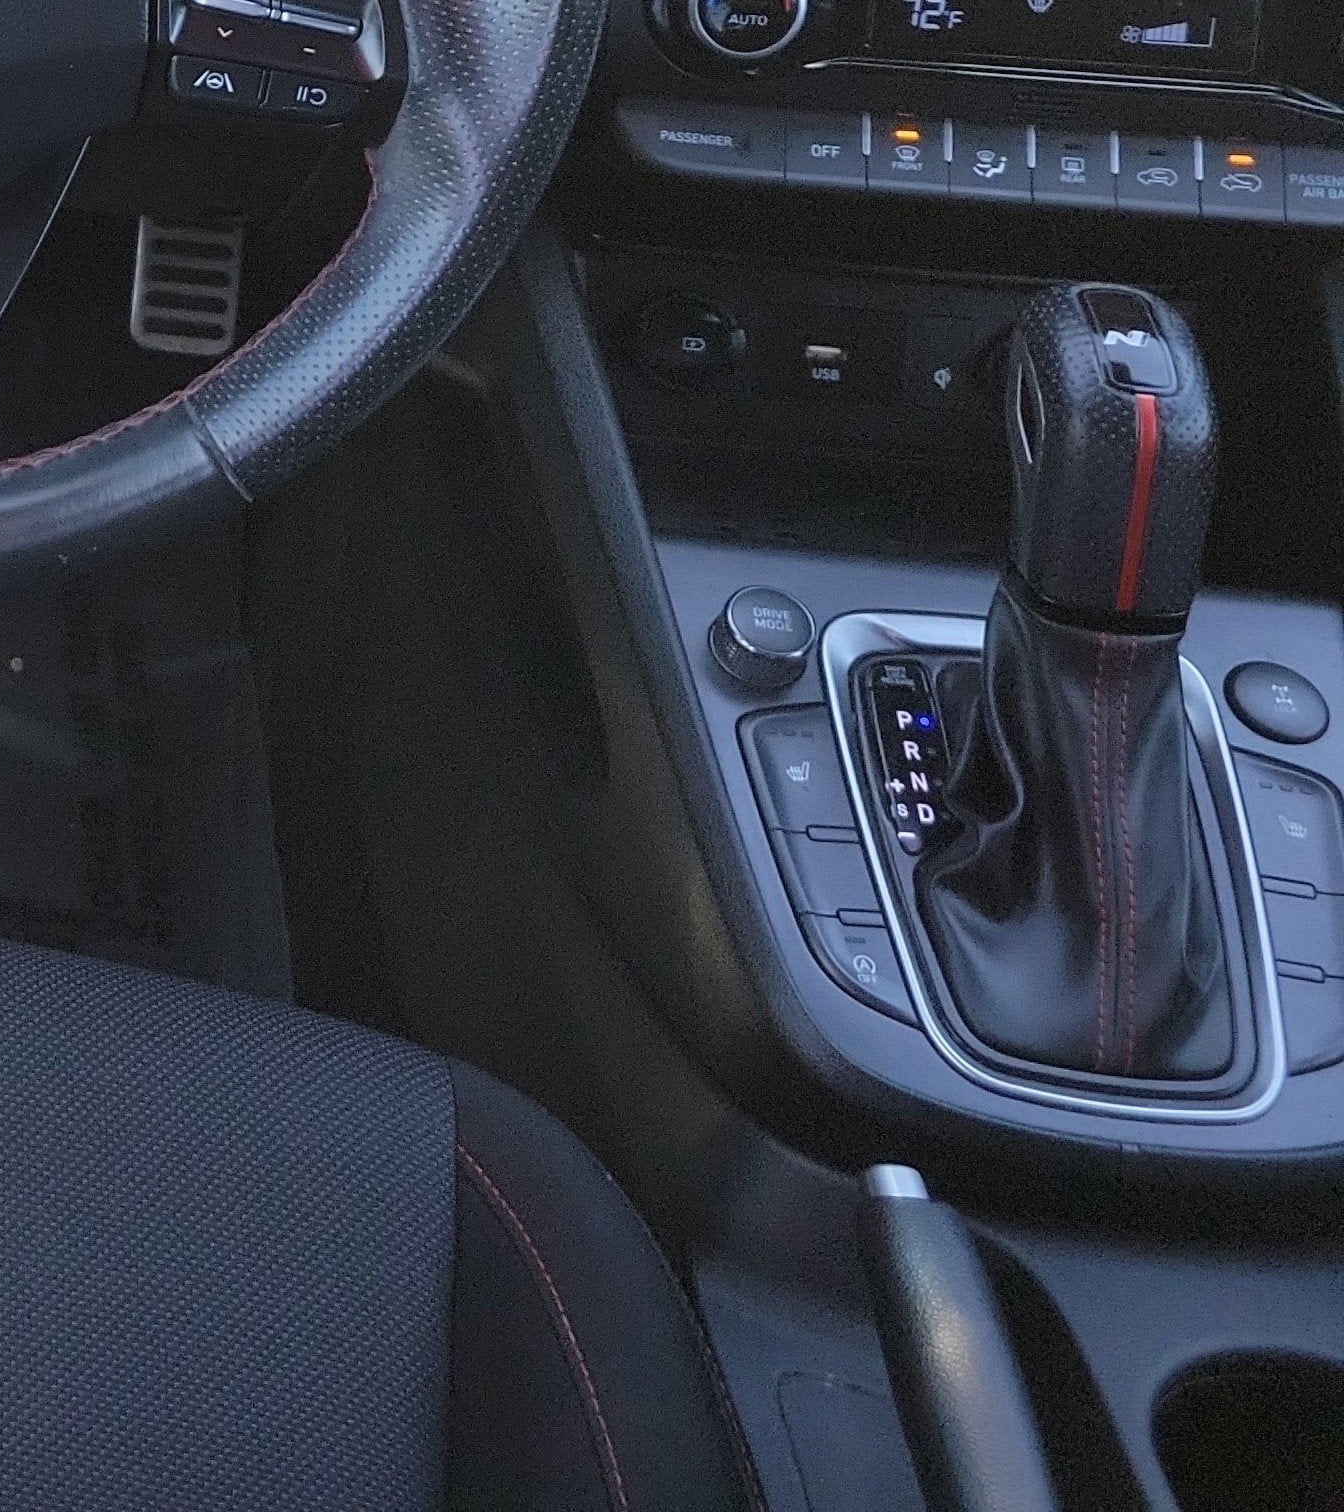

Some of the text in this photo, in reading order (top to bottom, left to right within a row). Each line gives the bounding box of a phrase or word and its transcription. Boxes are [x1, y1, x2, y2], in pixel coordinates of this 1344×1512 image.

[728, 14, 769, 27] AUTO
[660, 129, 733, 147] PASSENGER
[811, 143, 841, 159] OFF
[812, 368, 840, 382] USB
[896, 710, 912, 729] P
[903, 741, 921, 761] R
[910, 772, 928, 792] N
[917, 803, 935, 825] D
